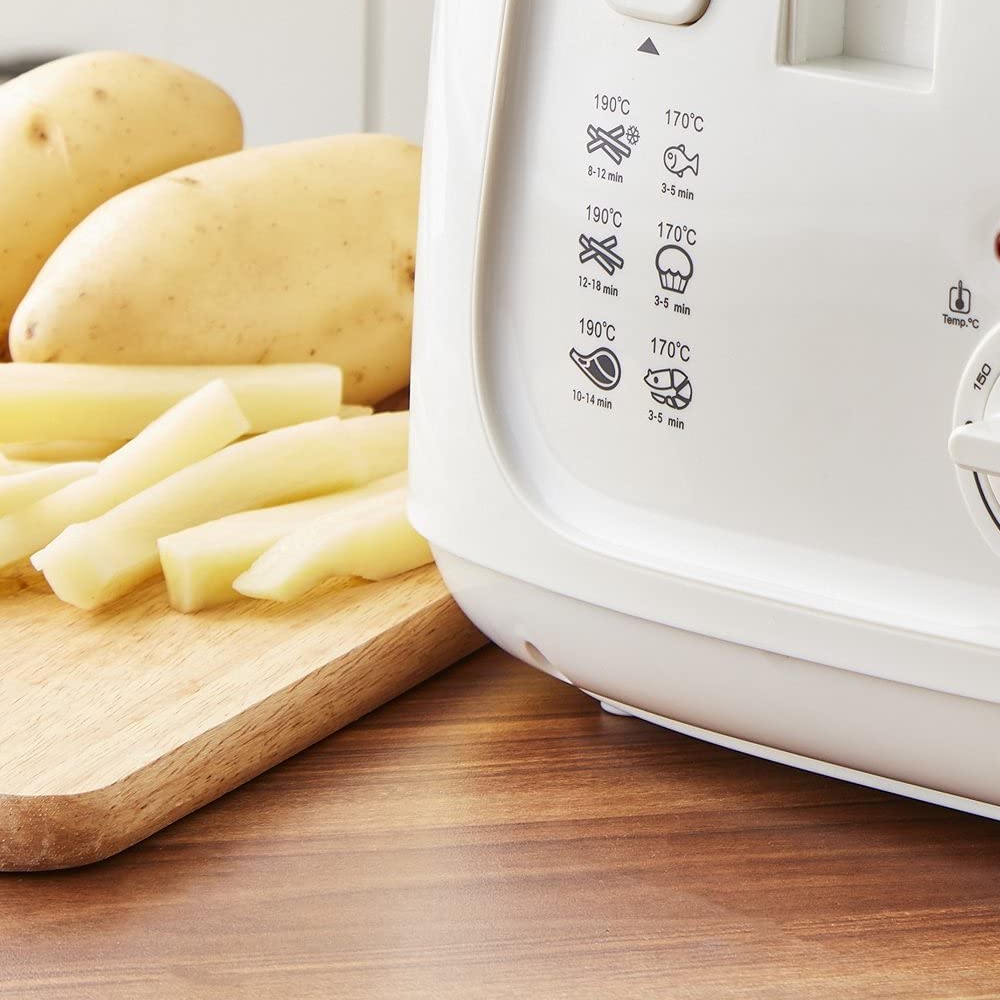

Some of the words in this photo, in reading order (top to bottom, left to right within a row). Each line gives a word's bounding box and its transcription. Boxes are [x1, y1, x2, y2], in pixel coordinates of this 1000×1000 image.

[594, 93, 631, 116] 190°C
[665, 109, 704, 133] 170°C
[587, 165, 607, 180] 8-12
[607, 171, 624, 184] min
[661, 182, 676, 197] 3-5
[677, 187, 695, 201] min
[585, 204, 623, 228] 190°C
[657, 221, 697, 246] 170°C
[578, 275, 602, 292] 12-18
[602, 283, 619, 297] min
[654, 295, 670, 309] 3-5
[673, 301, 692, 316] min
[578, 317, 617, 342] 190°C
[651, 337, 691, 362] 170°C
[973, 363, 993, 392] 150
[572, 389, 596, 406] 10-14
[596, 397, 613, 410] min
[648, 409, 664, 424] 3-5
[667, 415, 686, 430] min
